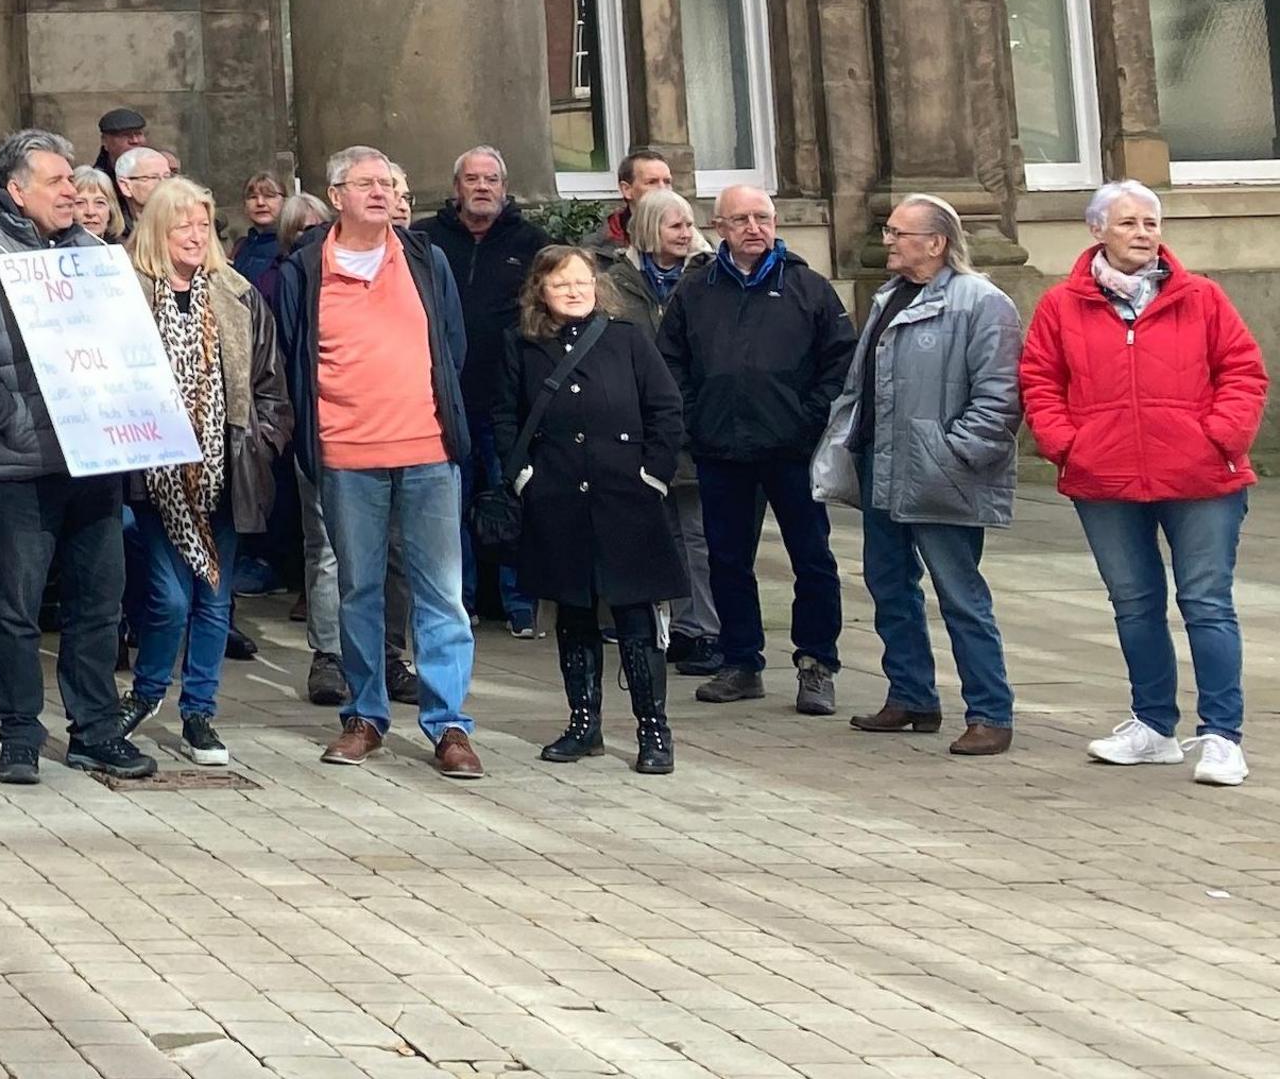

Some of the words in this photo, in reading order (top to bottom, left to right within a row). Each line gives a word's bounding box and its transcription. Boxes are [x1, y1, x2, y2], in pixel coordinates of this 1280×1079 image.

[45, 280, 74, 303] NO
[66, 348, 108, 373] YOU
[102, 421, 163, 446] THINK
